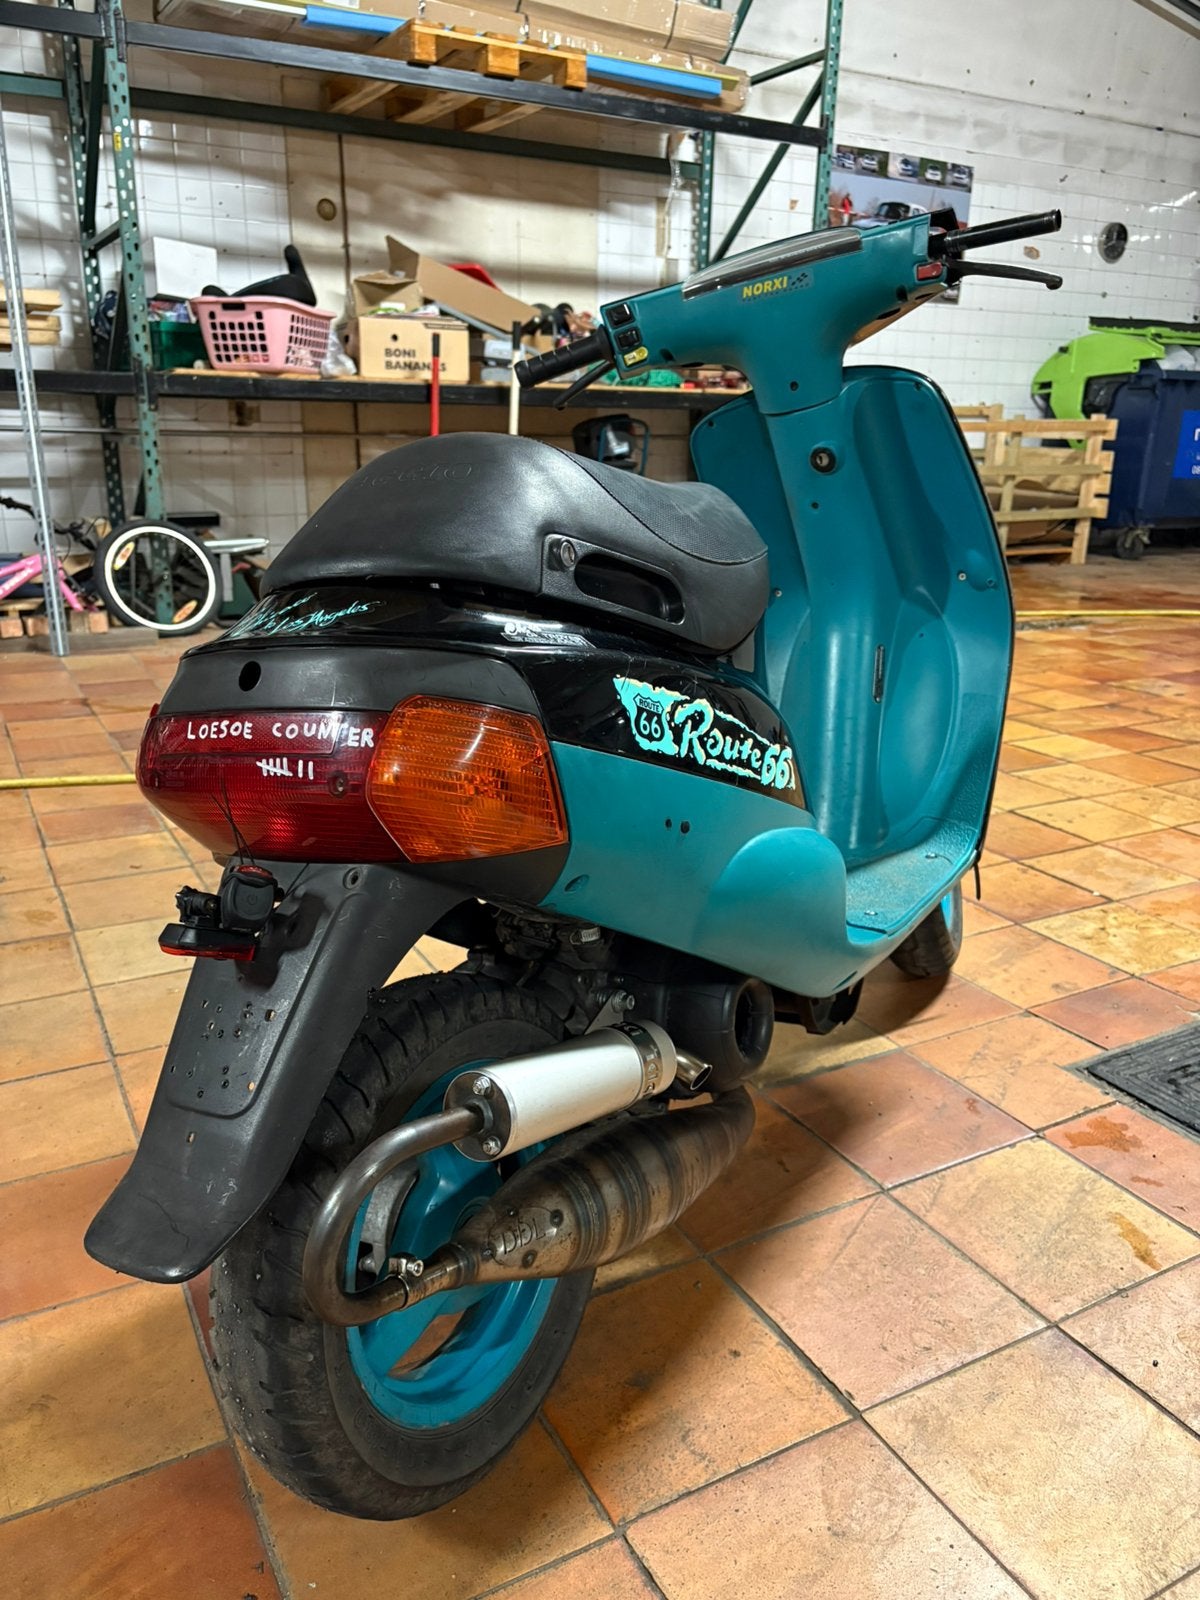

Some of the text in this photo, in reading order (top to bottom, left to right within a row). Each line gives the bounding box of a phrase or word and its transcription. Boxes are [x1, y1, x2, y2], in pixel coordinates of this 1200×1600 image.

[743, 276, 788, 298] NORXI
[384, 348, 416, 358] BONI
[385, 361, 447, 372] BANANS
[638, 698, 661, 712] ROUTE
[187, 720, 253, 740] LOESOE
[640, 711, 661, 739] 66
